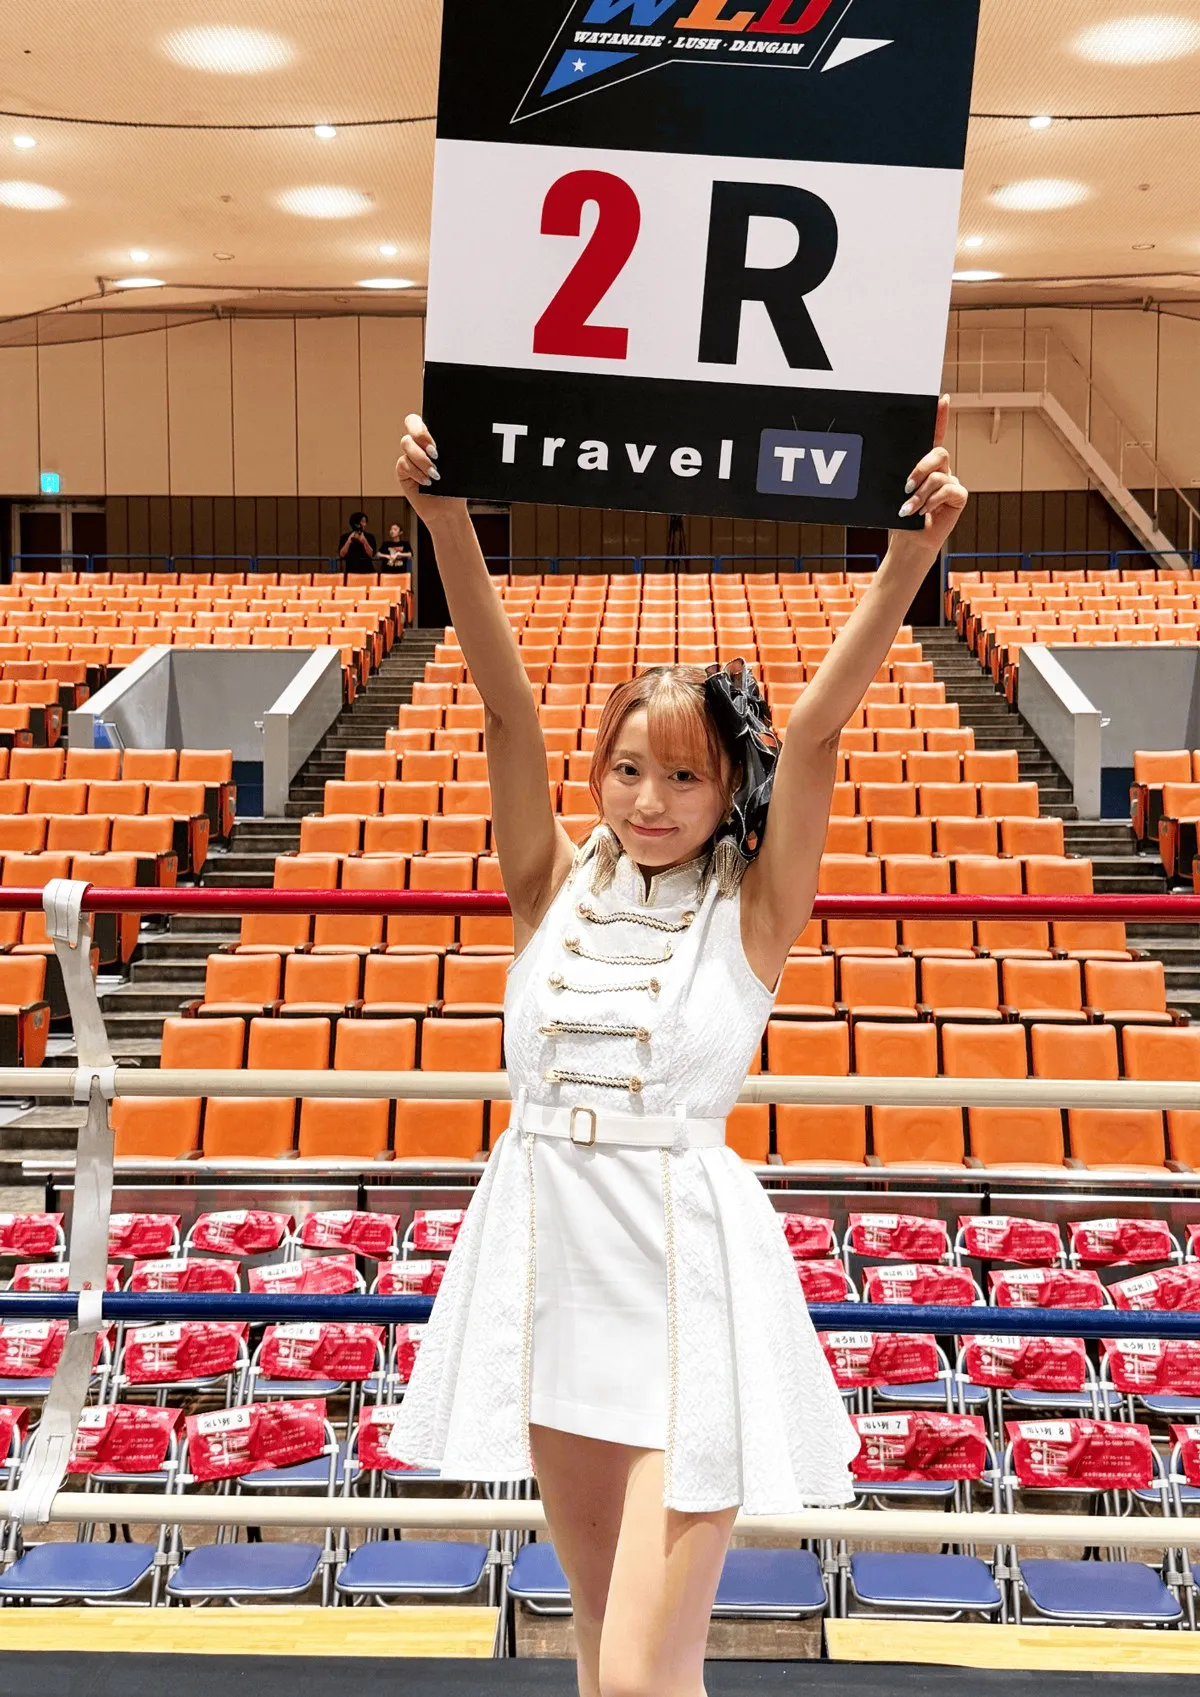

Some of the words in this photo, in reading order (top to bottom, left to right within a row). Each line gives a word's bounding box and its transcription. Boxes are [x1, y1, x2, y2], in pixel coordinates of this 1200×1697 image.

[573, 31, 665, 47] WATANABE
[674, 37, 723, 50] LUSH
[729, 40, 804, 54] DANGAN
[533, 169, 641, 360] 2
[698, 180, 838, 371] R
[492, 423, 733, 479] Travel
[774, 446, 847, 485] TV
[94, 1413, 100, 1422] 2
[237, 1413, 243, 1422] 3
[895, 1420, 902, 1430] 7
[1058, 1427, 1065, 1436] 8
